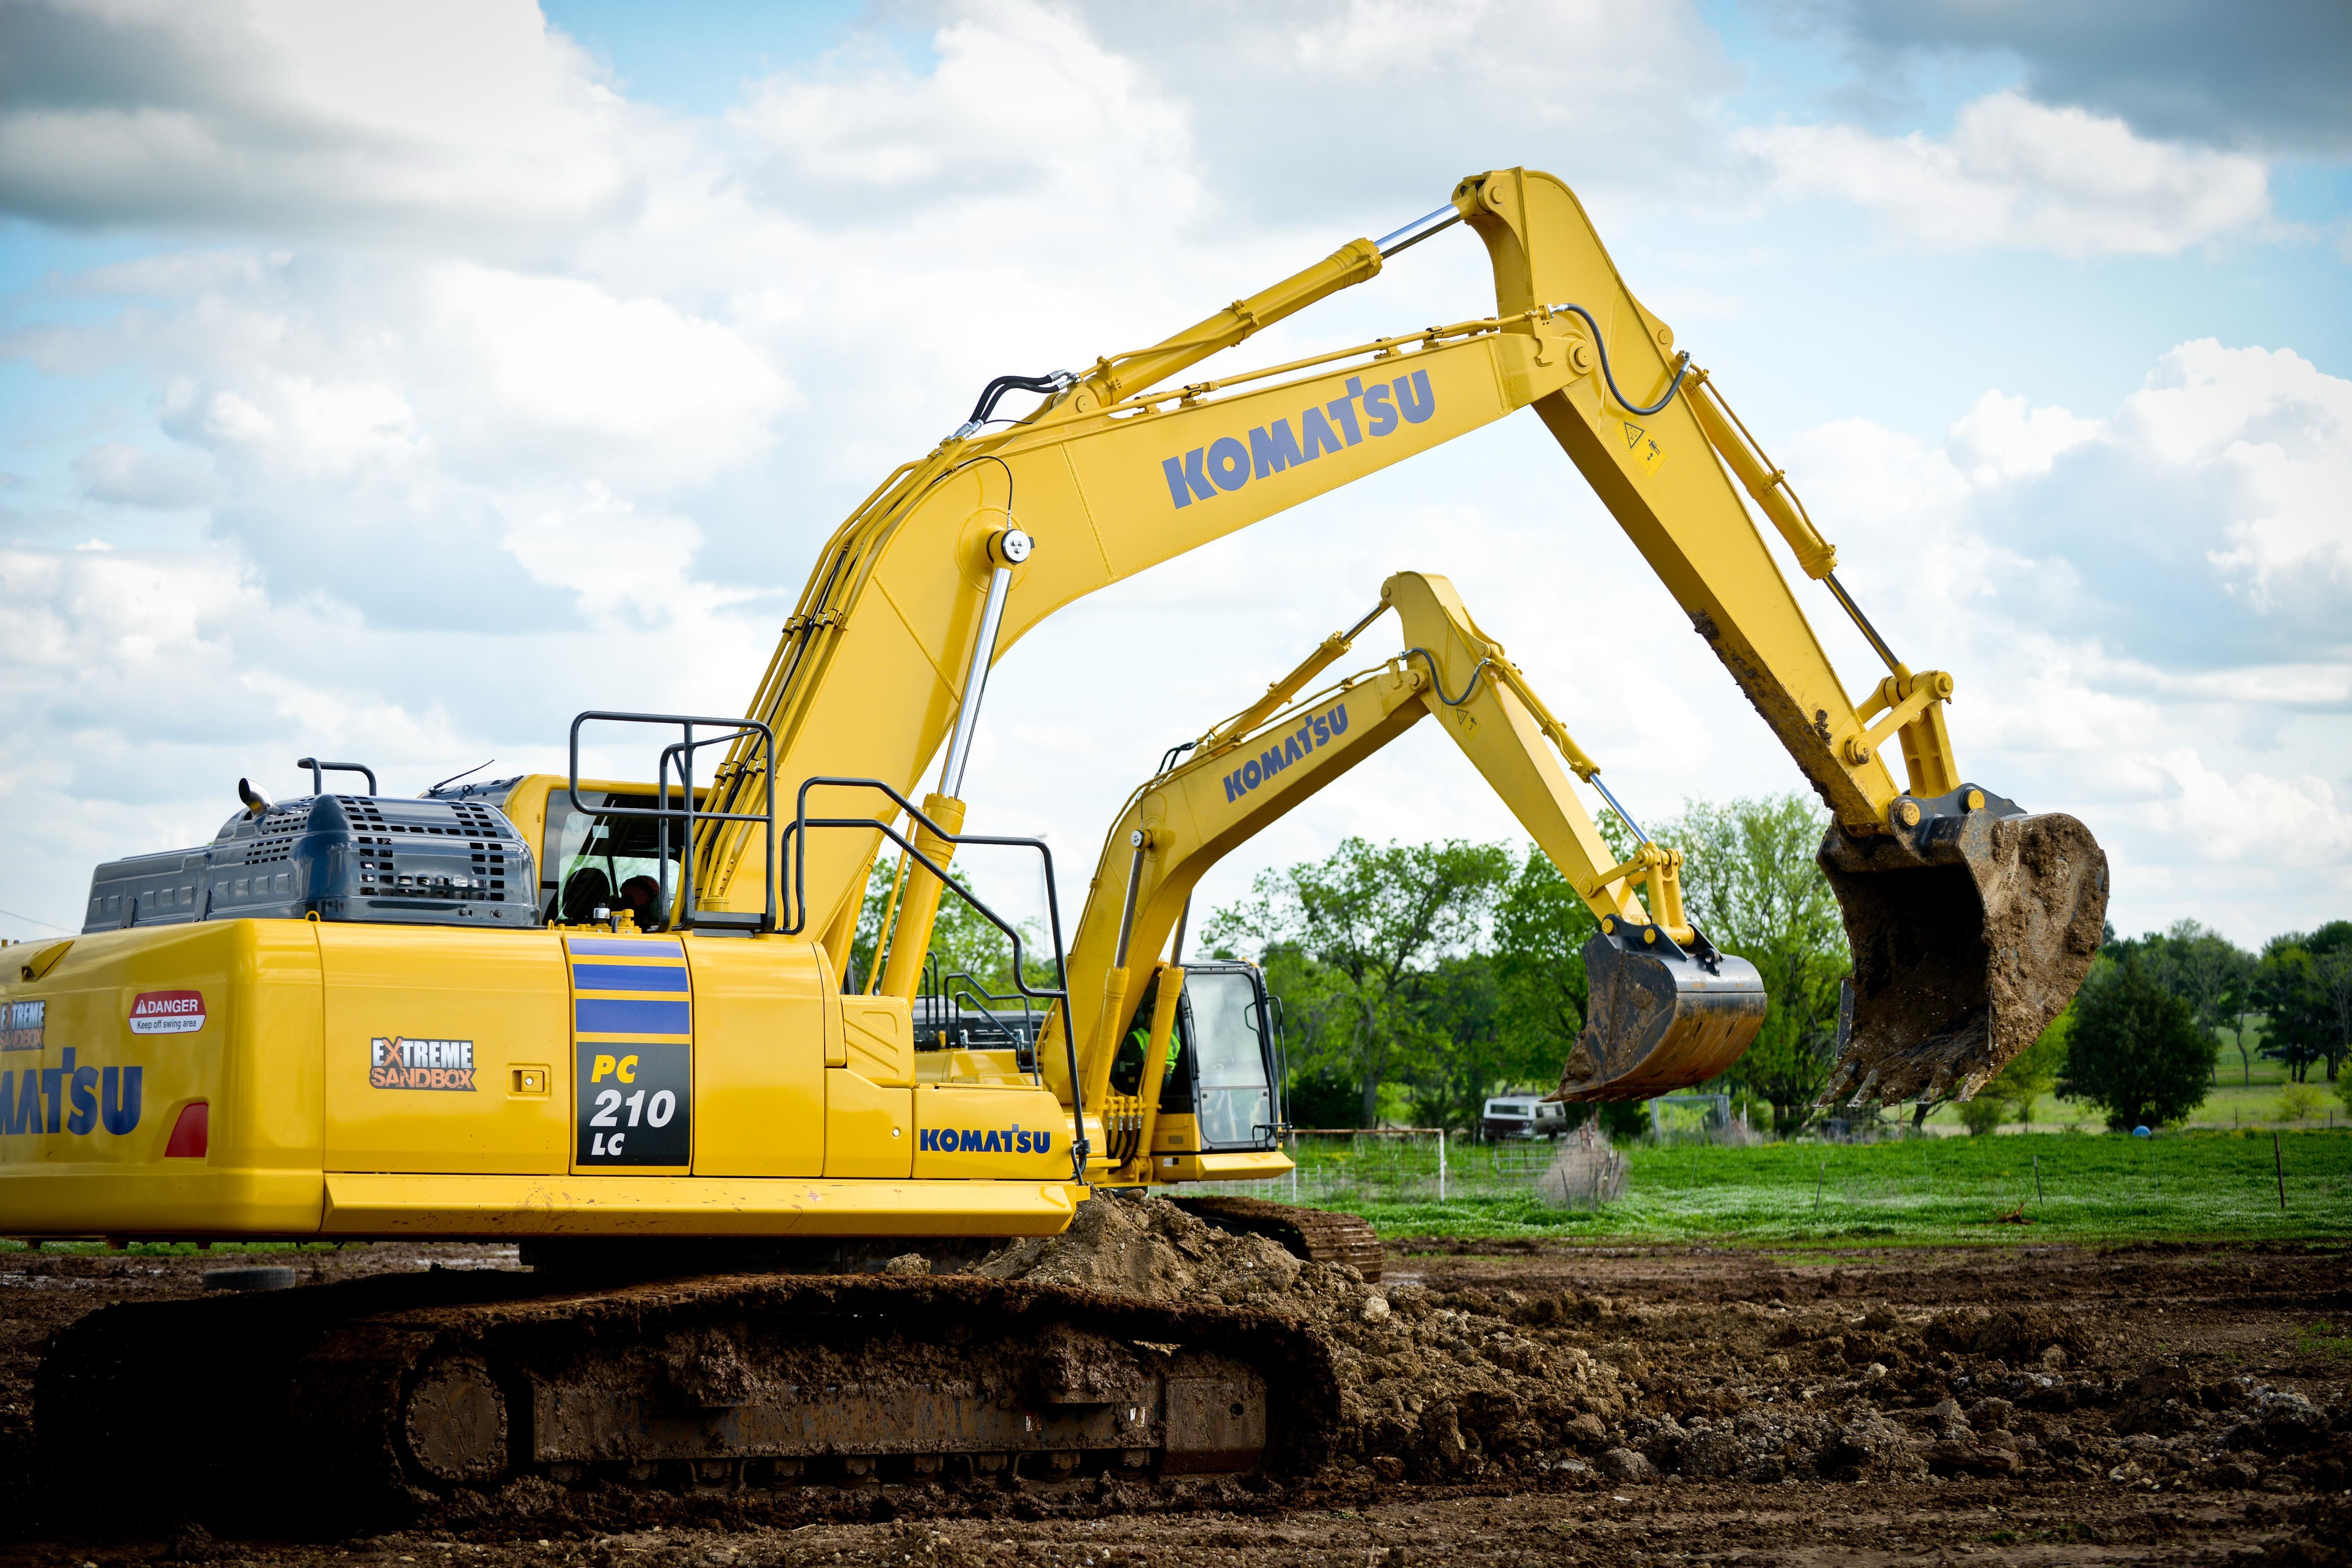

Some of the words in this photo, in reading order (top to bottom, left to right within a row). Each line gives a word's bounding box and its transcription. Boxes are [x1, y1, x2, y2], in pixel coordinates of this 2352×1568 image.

[1162, 369, 1435, 509] KOMATSU
[1223, 703, 1348, 804] KOMATSU
[1, 1001, 45, 1030] EXTREME
[148, 999, 198, 1013] DANGER
[137, 1020, 152, 1030] Keep
[163, 1019, 181, 1029] swing
[372, 1038, 472, 1068] EXTREME
[371, 1067, 473, 1089] SANDBOX
[591, 1055, 638, 1083] PC
[589, 1089, 676, 1127] 210
[591, 1133, 625, 1155] LC
[920, 1124, 1050, 1153] KOMATSU
